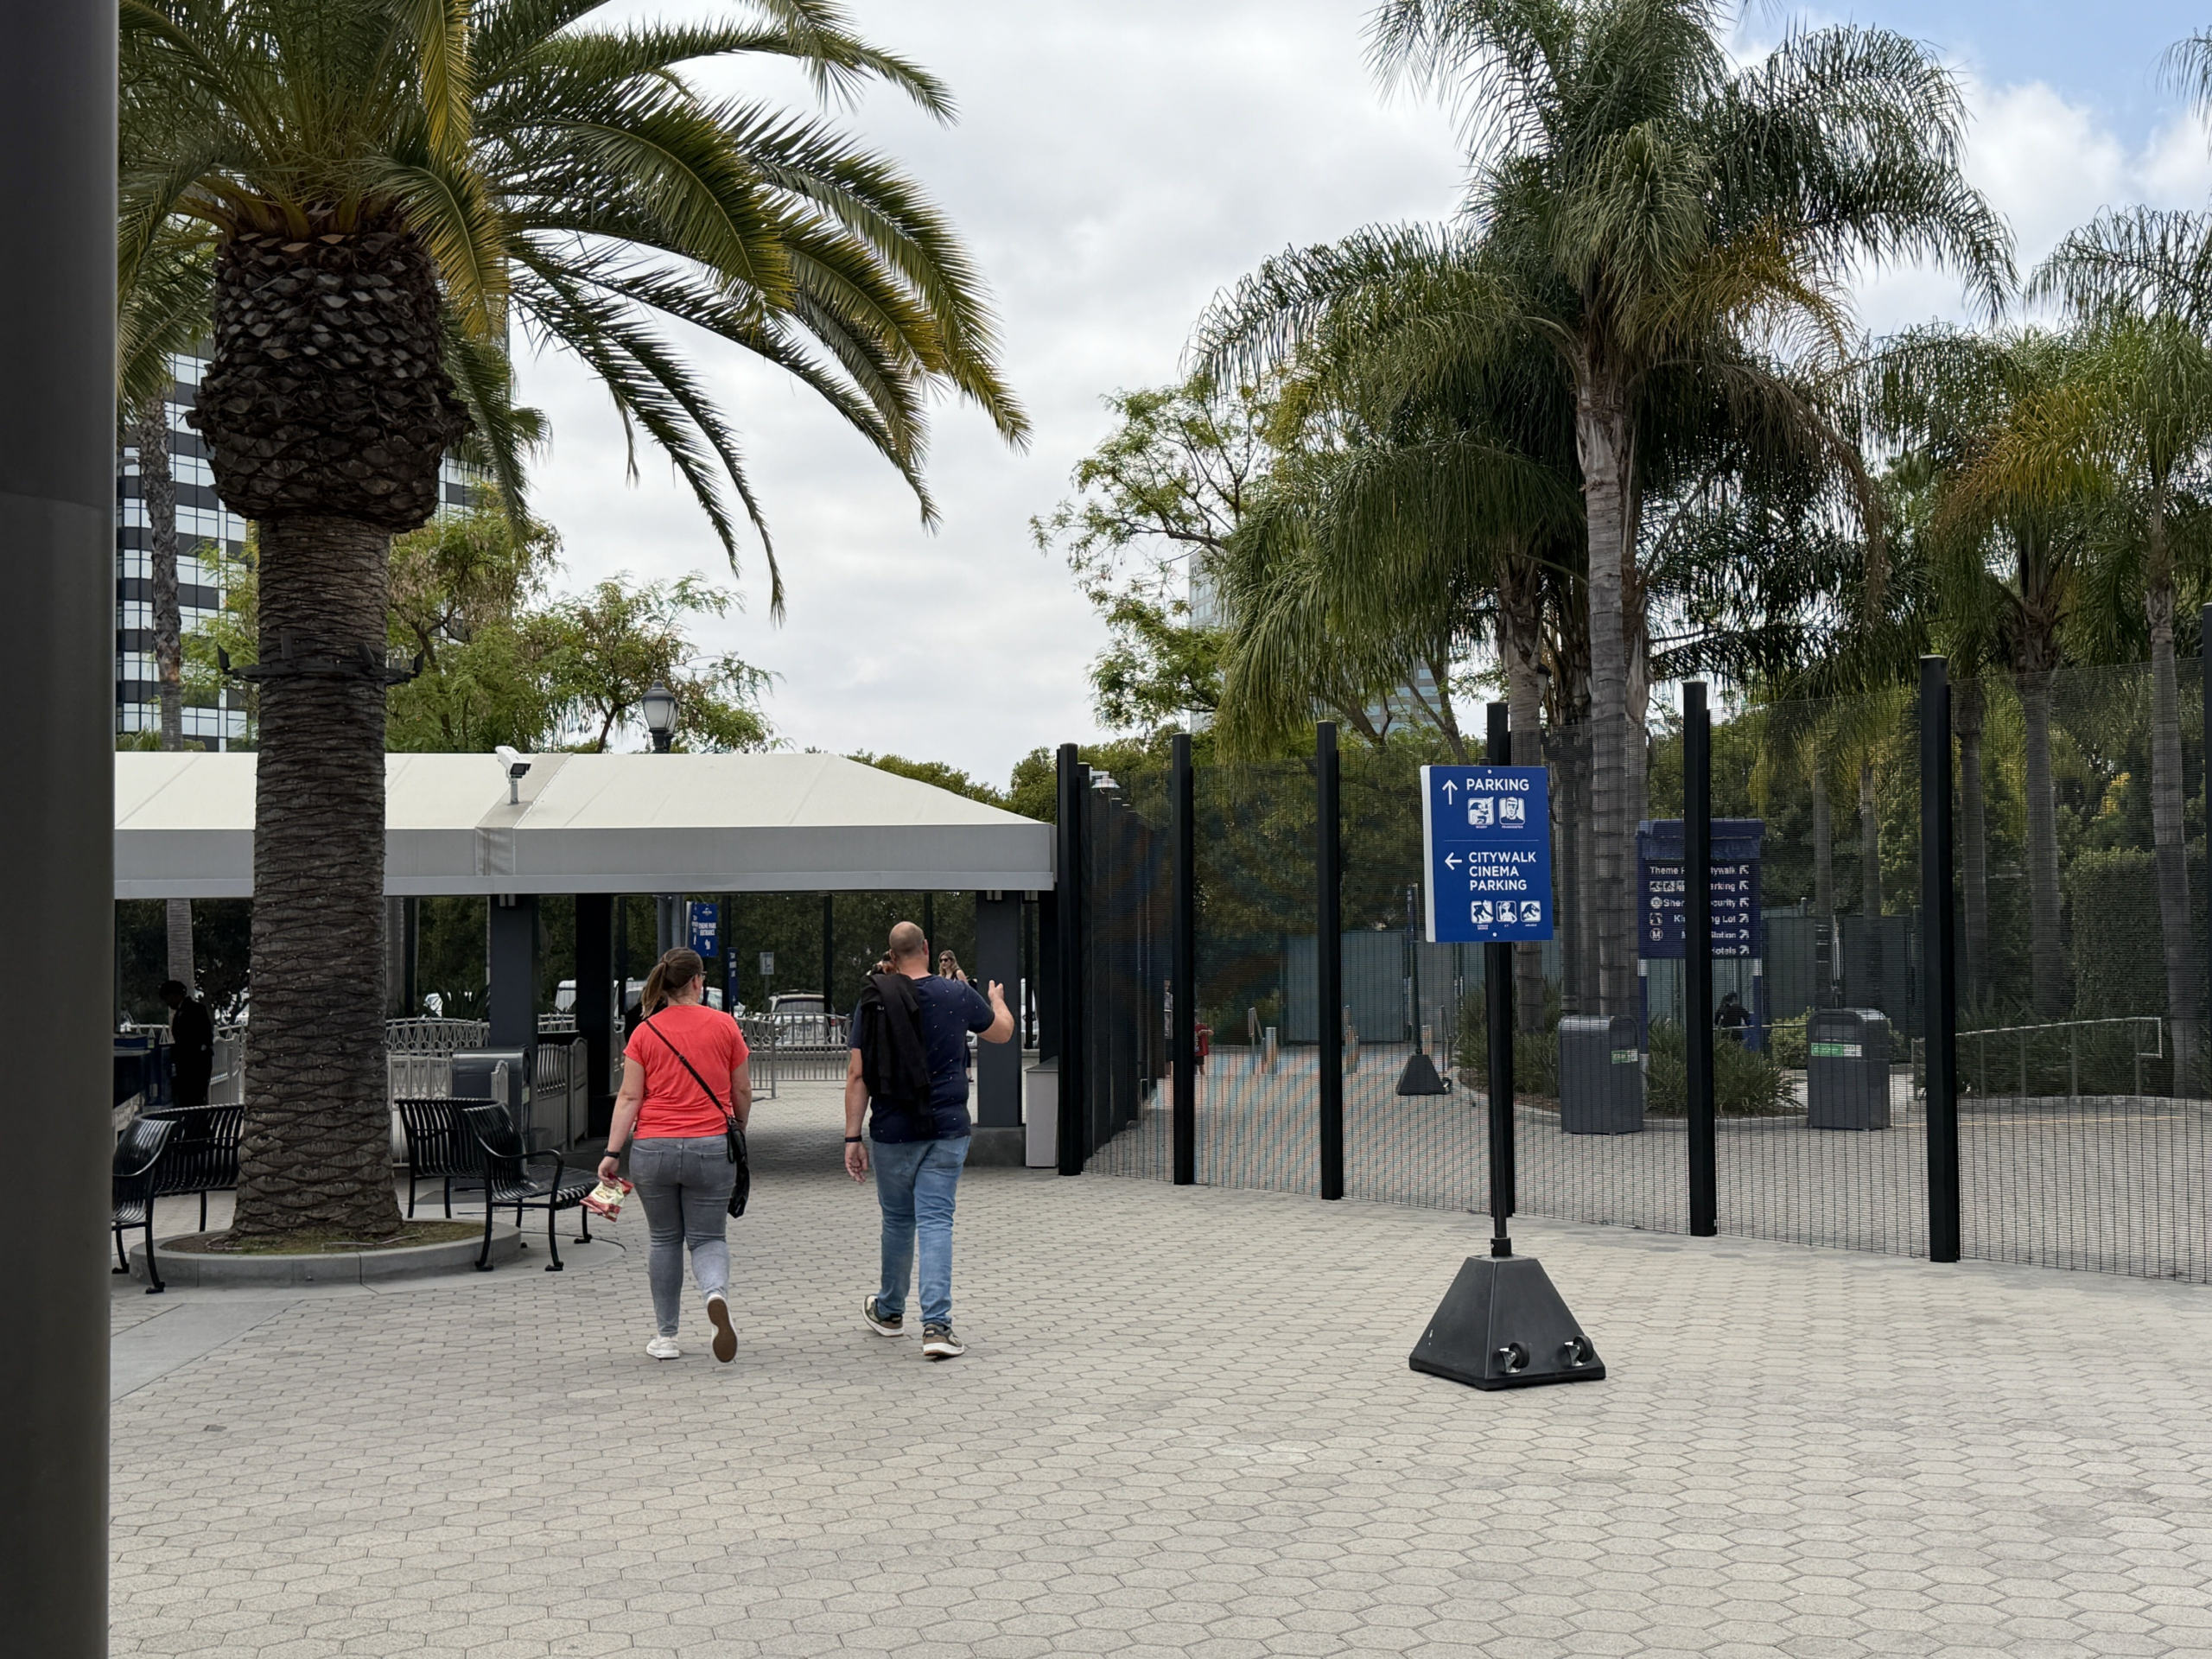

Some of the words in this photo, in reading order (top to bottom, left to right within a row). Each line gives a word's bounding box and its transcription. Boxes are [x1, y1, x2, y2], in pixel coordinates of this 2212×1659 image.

[1466, 779, 1529, 791] PARKING
[1468, 851, 1536, 863] CITYWALK
[1469, 866, 1519, 877] CINEMA
[1470, 880, 1527, 891] PARKING
[1711, 882, 1735, 892] arking
[1711, 899, 1736, 908] curity
